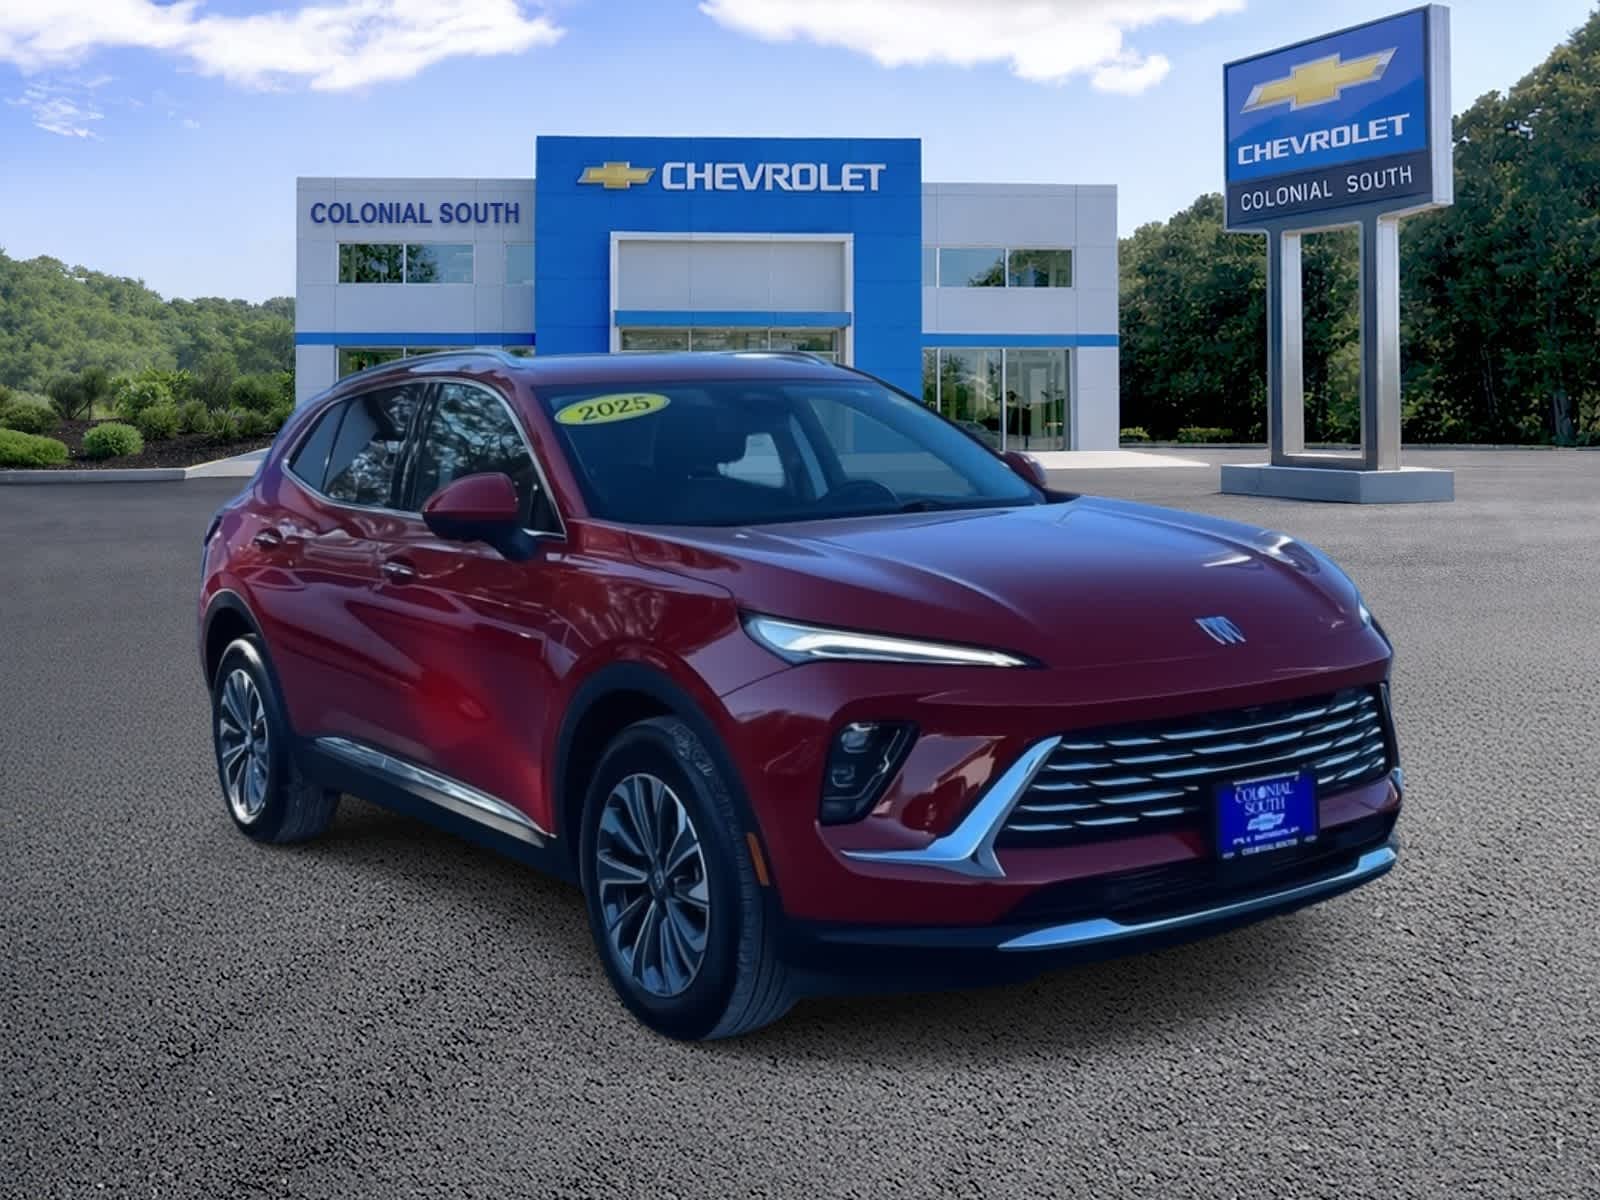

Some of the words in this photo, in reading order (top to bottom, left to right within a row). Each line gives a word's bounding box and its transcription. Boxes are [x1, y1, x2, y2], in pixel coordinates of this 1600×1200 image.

[1237, 113, 1410, 165] CHEVROLET
[662, 162, 886, 192] CHEVROLET
[1241, 180, 1333, 211] COLONIAL
[1346, 165, 1413, 193] SOUTH
[310, 202, 433, 225] COLONIAL
[439, 202, 520, 225] SOUTH
[578, 396, 651, 421] 2025
[1235, 783, 1294, 804] COLONIAL
[1244, 797, 1285, 816] SOUTH
